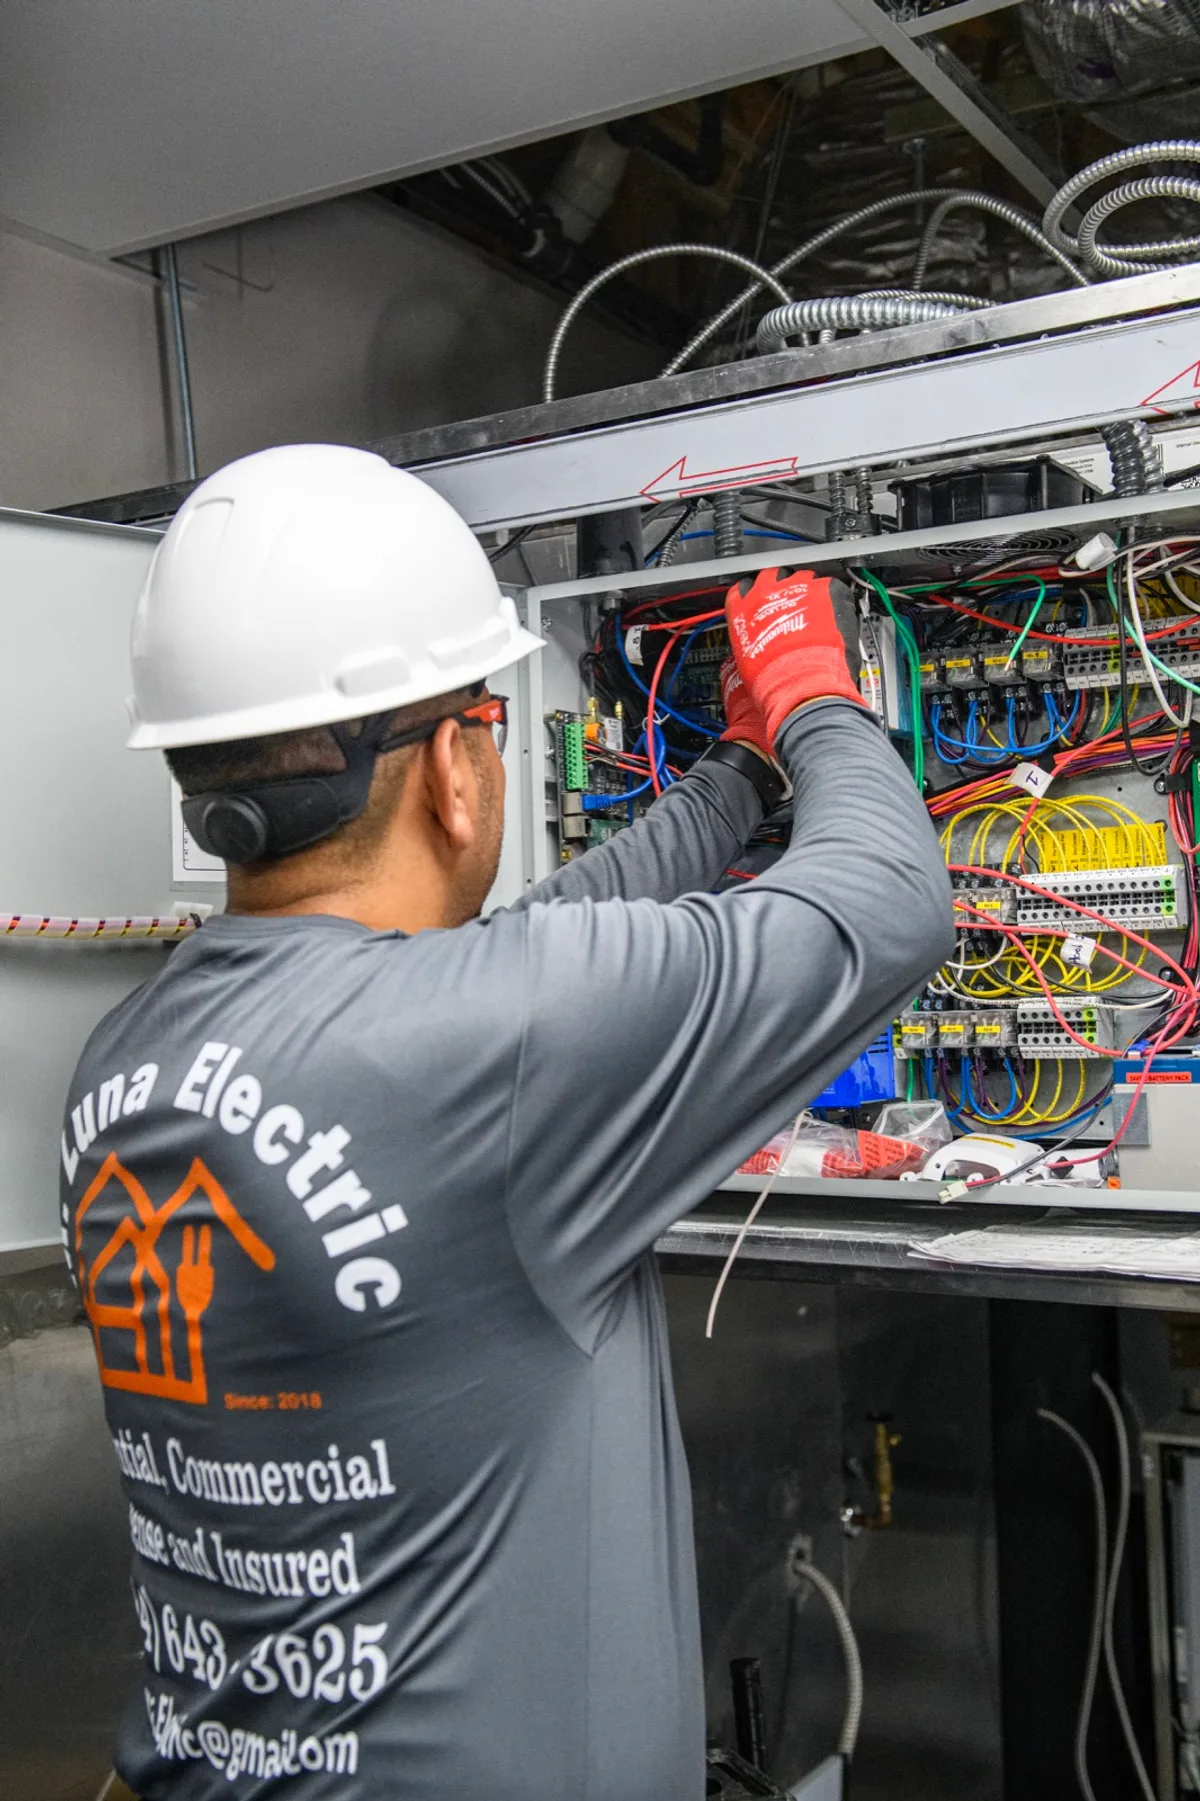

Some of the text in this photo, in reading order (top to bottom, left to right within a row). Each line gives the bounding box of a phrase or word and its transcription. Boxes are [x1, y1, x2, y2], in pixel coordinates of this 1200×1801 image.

[61, 1061, 160, 1185] Luna
[172, 1041, 409, 1313] Electric
[167, 1438, 397, 1506] Commercial
[167, 1526, 217, 1582] and
[211, 1531, 363, 1598] Insured
